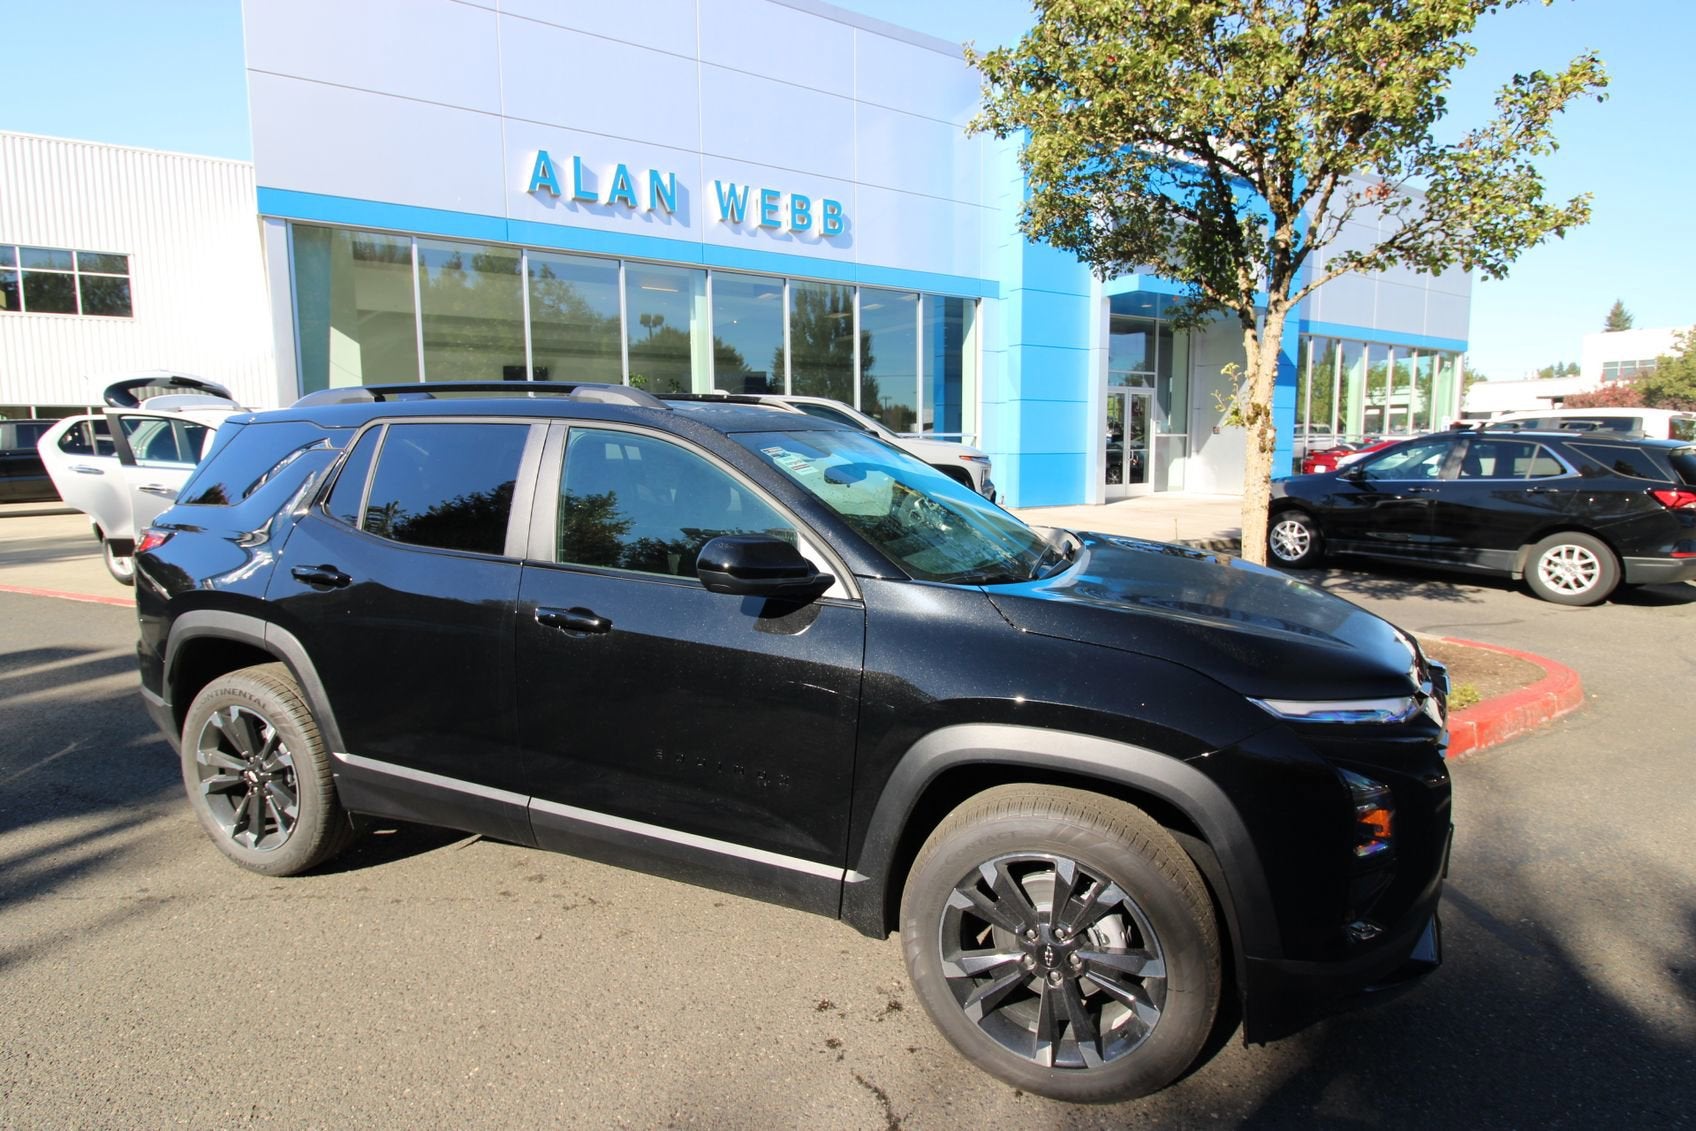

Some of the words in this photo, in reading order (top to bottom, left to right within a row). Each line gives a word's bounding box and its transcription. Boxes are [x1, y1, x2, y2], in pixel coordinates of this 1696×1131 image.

[527, 149, 678, 214] ALAN
[714, 179, 845, 237] WEBB
[196, 687, 267, 710] ONTINENTAL
